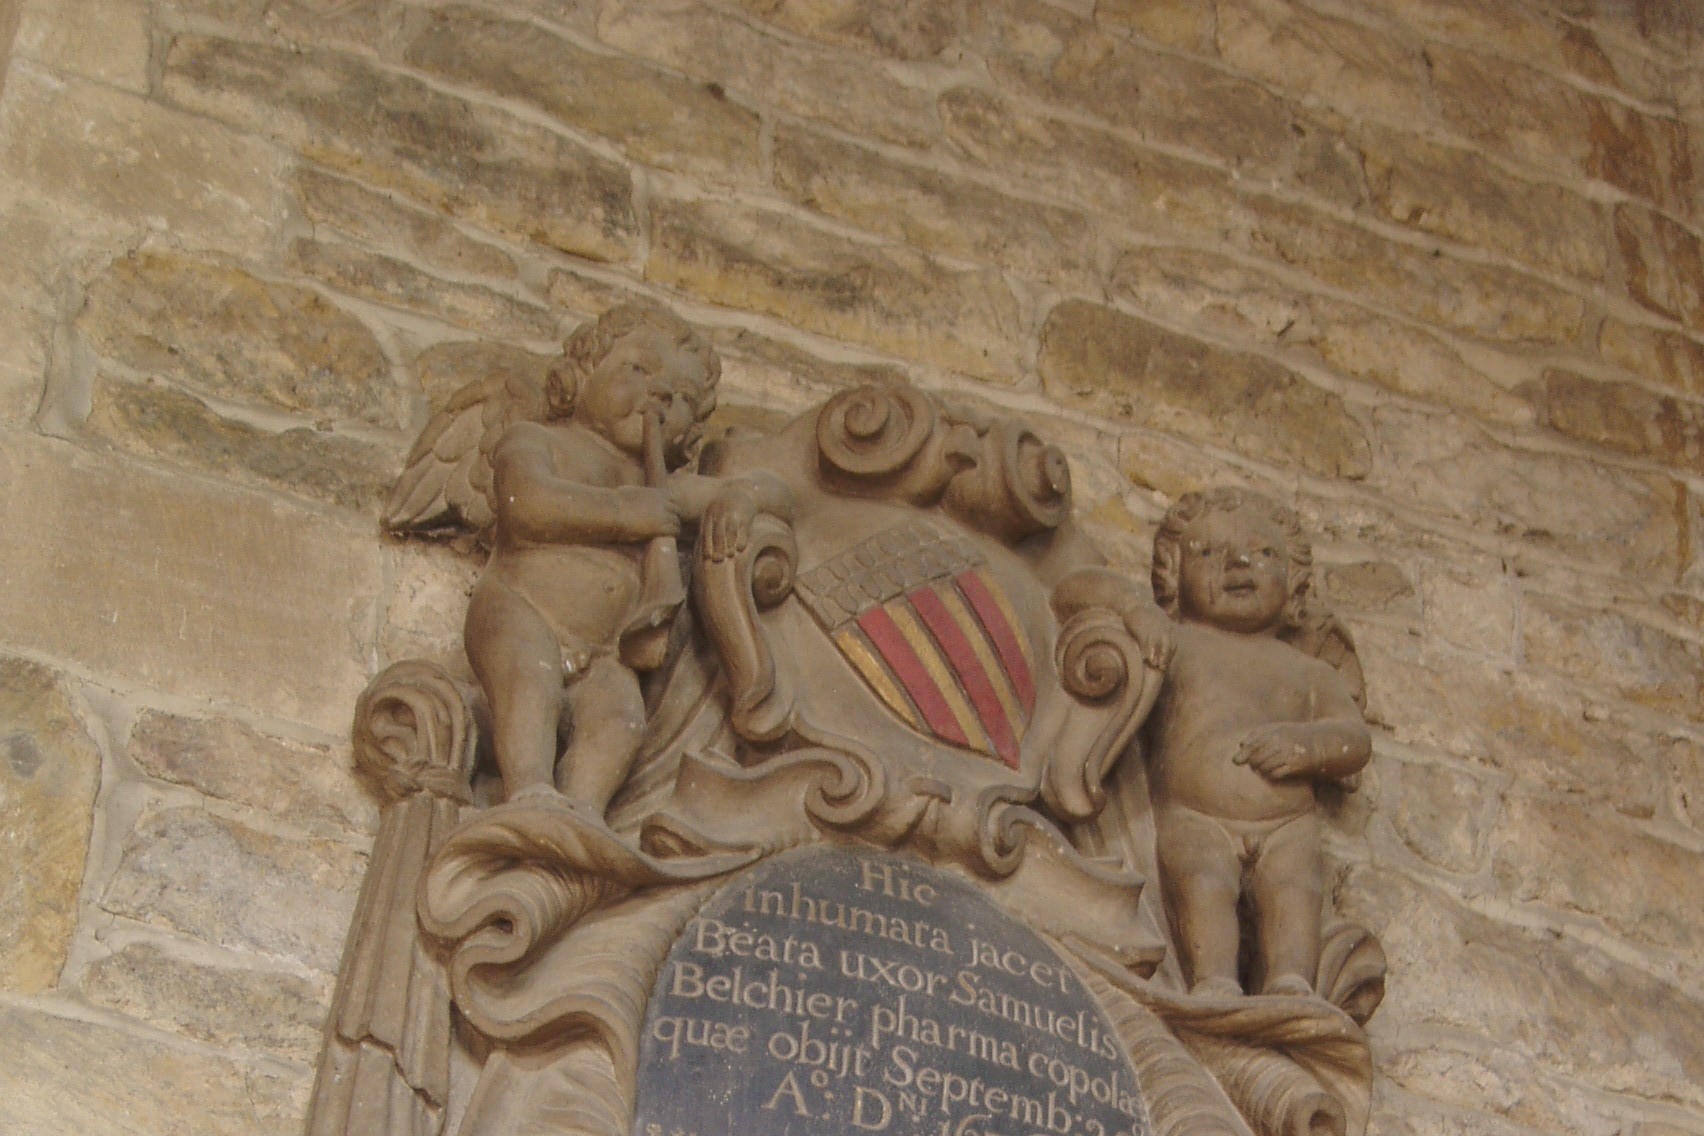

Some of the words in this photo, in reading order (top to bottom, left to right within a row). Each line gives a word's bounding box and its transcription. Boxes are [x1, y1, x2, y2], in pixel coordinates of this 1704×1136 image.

[743, 873, 954, 954] inhumata
[966, 922, 1073, 994] jacet
[859, 857, 938, 905] Hic
[670, 960, 859, 1023] Belchier
[690, 917, 823, 969] Beata
[840, 950, 948, 997] uxor
[950, 970, 1119, 1060] Samuelis
[651, 1015, 749, 1061] quæ
[767, 1020, 871, 1079] obijt
[882, 1045, 1083, 1134] Septemb:
